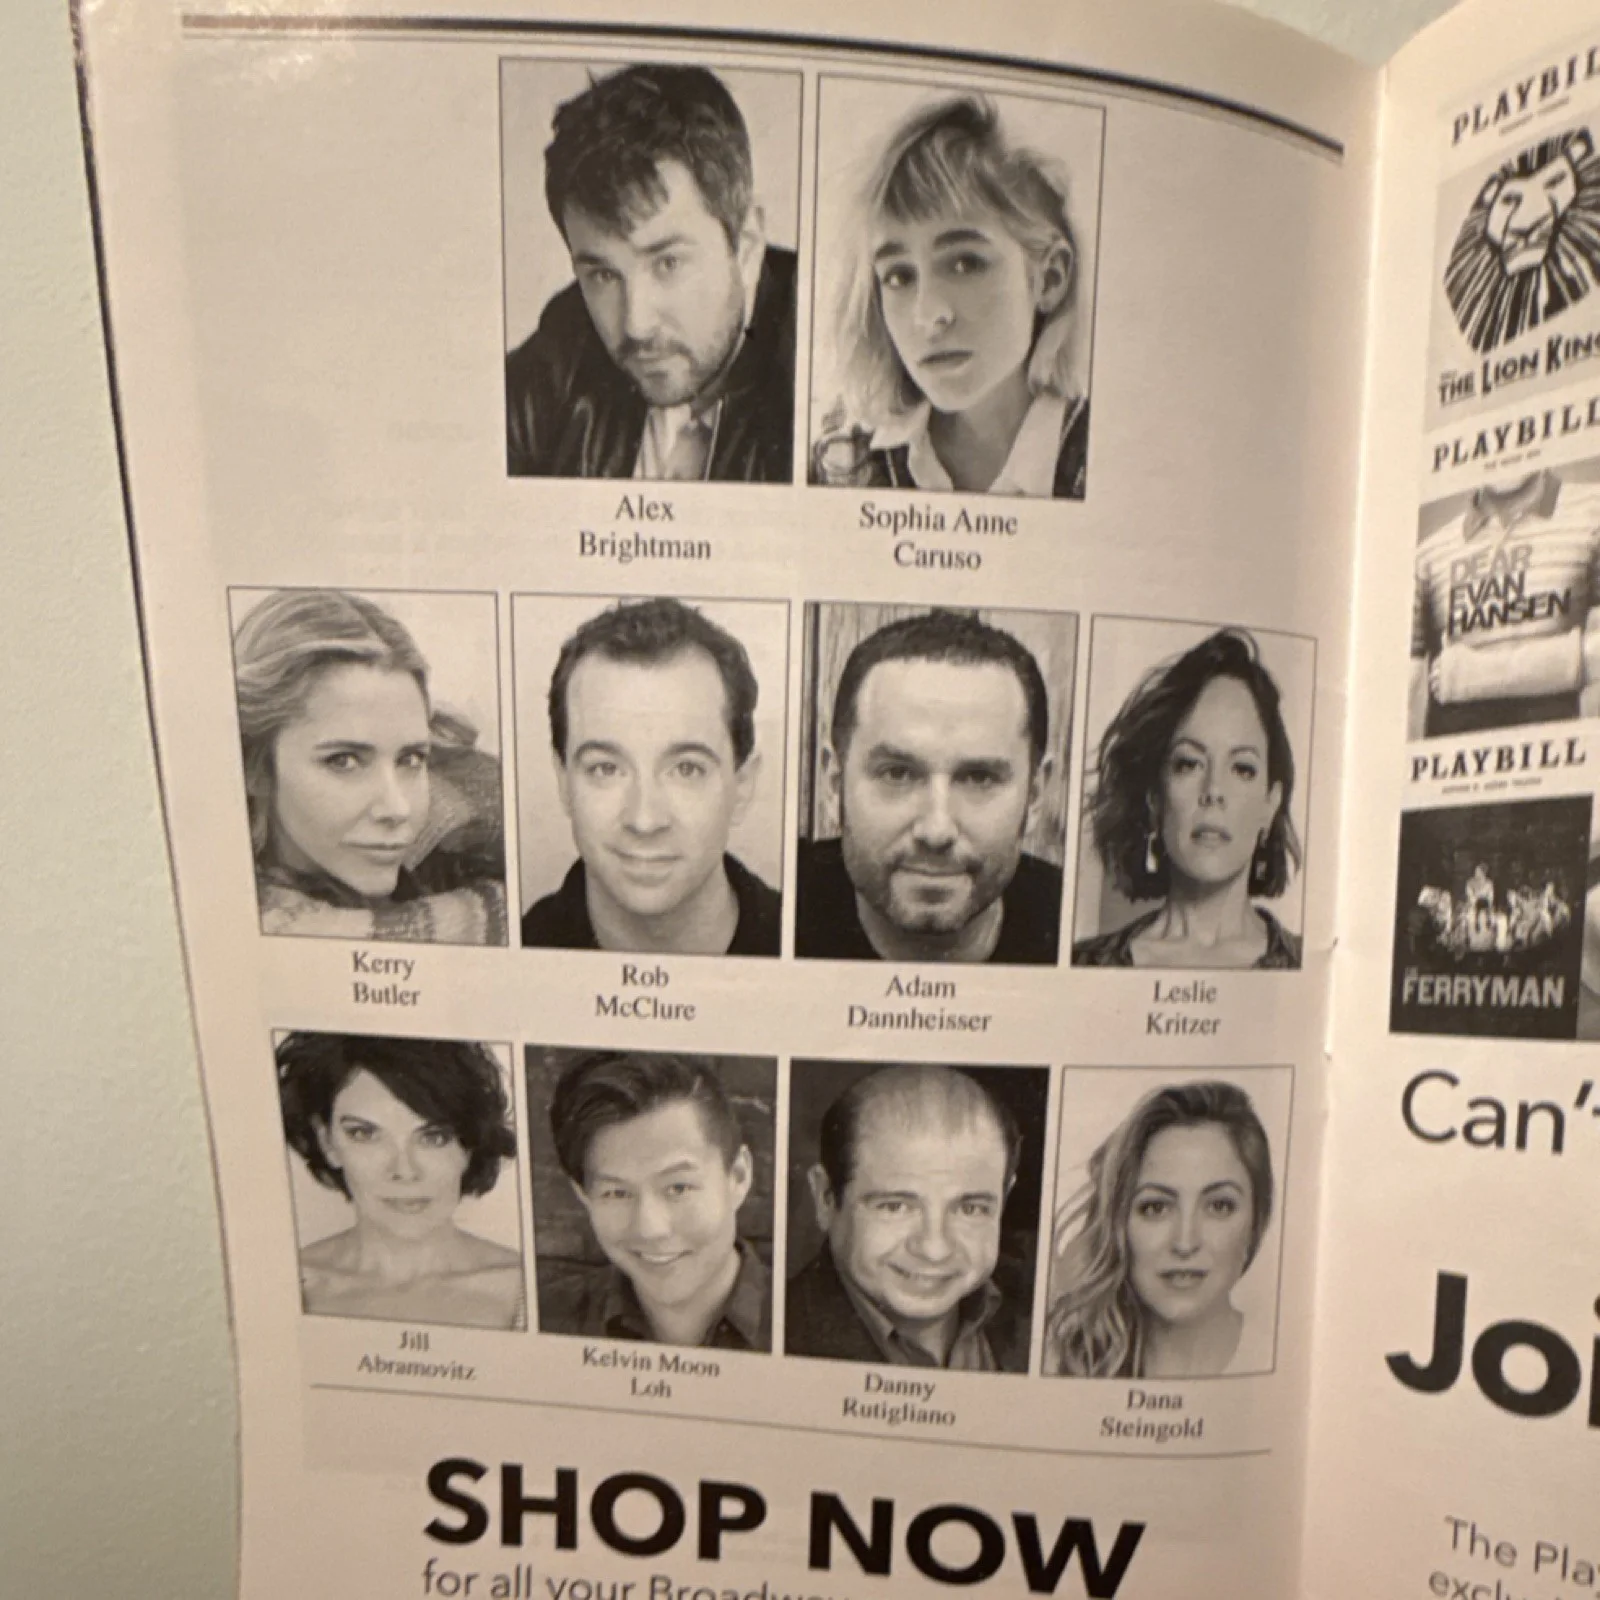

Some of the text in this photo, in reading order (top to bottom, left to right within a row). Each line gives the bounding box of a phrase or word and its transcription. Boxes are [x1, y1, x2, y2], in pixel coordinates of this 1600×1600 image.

[1439, 370, 1475, 406] THE
[1482, 349, 1539, 394] LION
[1432, 396, 1600, 472] PLAYBILL
[615, 494, 675, 522] Alex
[859, 503, 1018, 536] Sophia Anne
[578, 531, 712, 563] Brightman
[893, 541, 982, 571] Caruso
[1450, 543, 1533, 590] DEAR
[1449, 570, 1526, 614] EVAN
[1448, 586, 1571, 638] HANSEN
[1411, 736, 1587, 782] PLAYBILL
[352, 951, 415, 980] Kerry
[621, 964, 670, 988] Rob
[353, 983, 421, 1006] Butler
[885, 975, 956, 999] Adam
[1153, 980, 1217, 1005] Leslie
[1402, 973, 1565, 1009] FERRYMAN
[595, 995, 696, 1021] McClure
[847, 1005, 992, 1032] Dannheisser
[1145, 1013, 1221, 1036] Kritzer
[398, 1331, 430, 1351] Jill
[358, 1353, 477, 1381] Abramovitz
[582, 1346, 720, 1377] Kelvin Moon
[630, 1377, 671, 1399] Loh
[864, 1372, 936, 1401] Danny
[1126, 1389, 1183, 1411] Dana
[842, 1397, 956, 1427] Rutigliano
[1100, 1416, 1204, 1444] Steingold
[424, 1457, 1146, 1600] SHOP NOW
[1444, 1514, 1517, 1568] The
[1533, 1539, 1600, 1587] Pla
[422, 1556, 480, 1597] for
[490, 1563, 533, 1600] all
[546, 1576, 637, 1600] your
